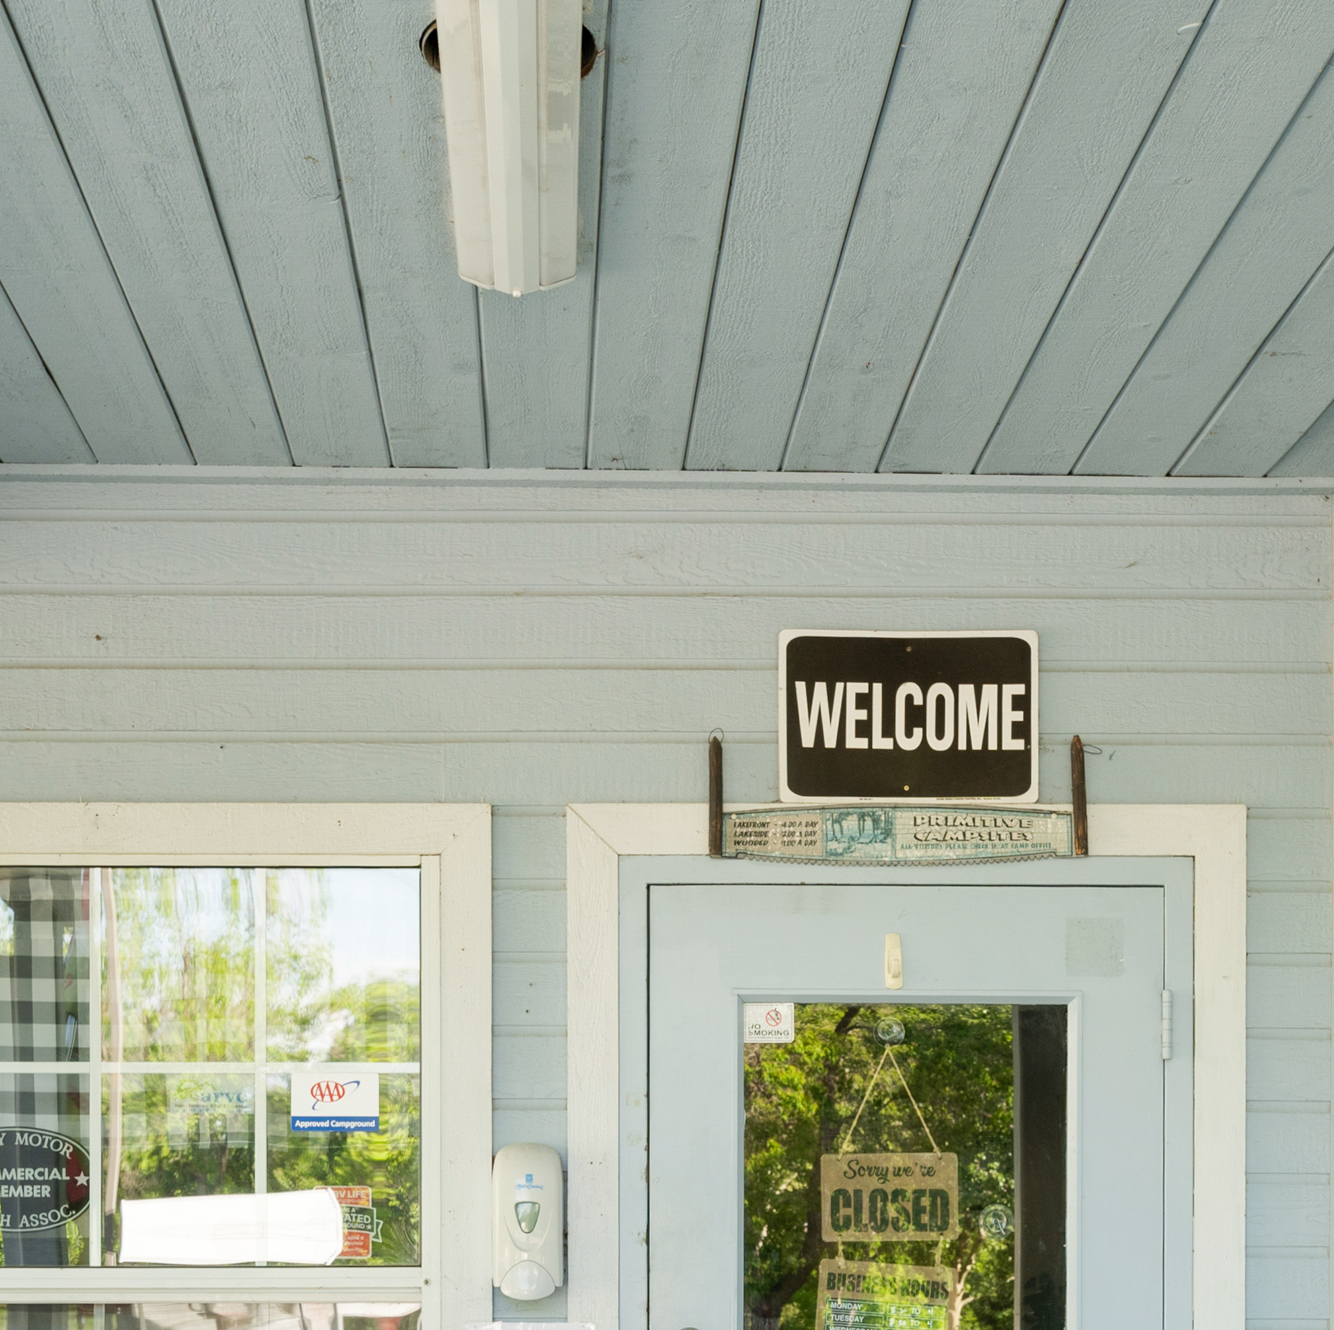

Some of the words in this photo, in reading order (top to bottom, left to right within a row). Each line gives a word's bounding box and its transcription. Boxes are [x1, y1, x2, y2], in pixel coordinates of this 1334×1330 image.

[795, 681, 1026, 751] WELCOME
[914, 815, 1033, 828] PRIMITIVE
[914, 830, 1034, 842] CAMPSITES
[311, 1081, 345, 1102] AAA
[295, 1120, 329, 1128] Approved
[331, 1120, 375, 1128] Campground
[15, 1132, 74, 1159] MOTOR
[843, 1159, 890, 1184] Sorry
[348, 1190, 366, 1198] LIFE
[19, 1205, 76, 1227] ASSOC.
[831, 1188, 949, 1233] CLOSED
[827, 1272, 896, 1295] BUSINESS
[901, 1279, 949, 1298] HOURS
